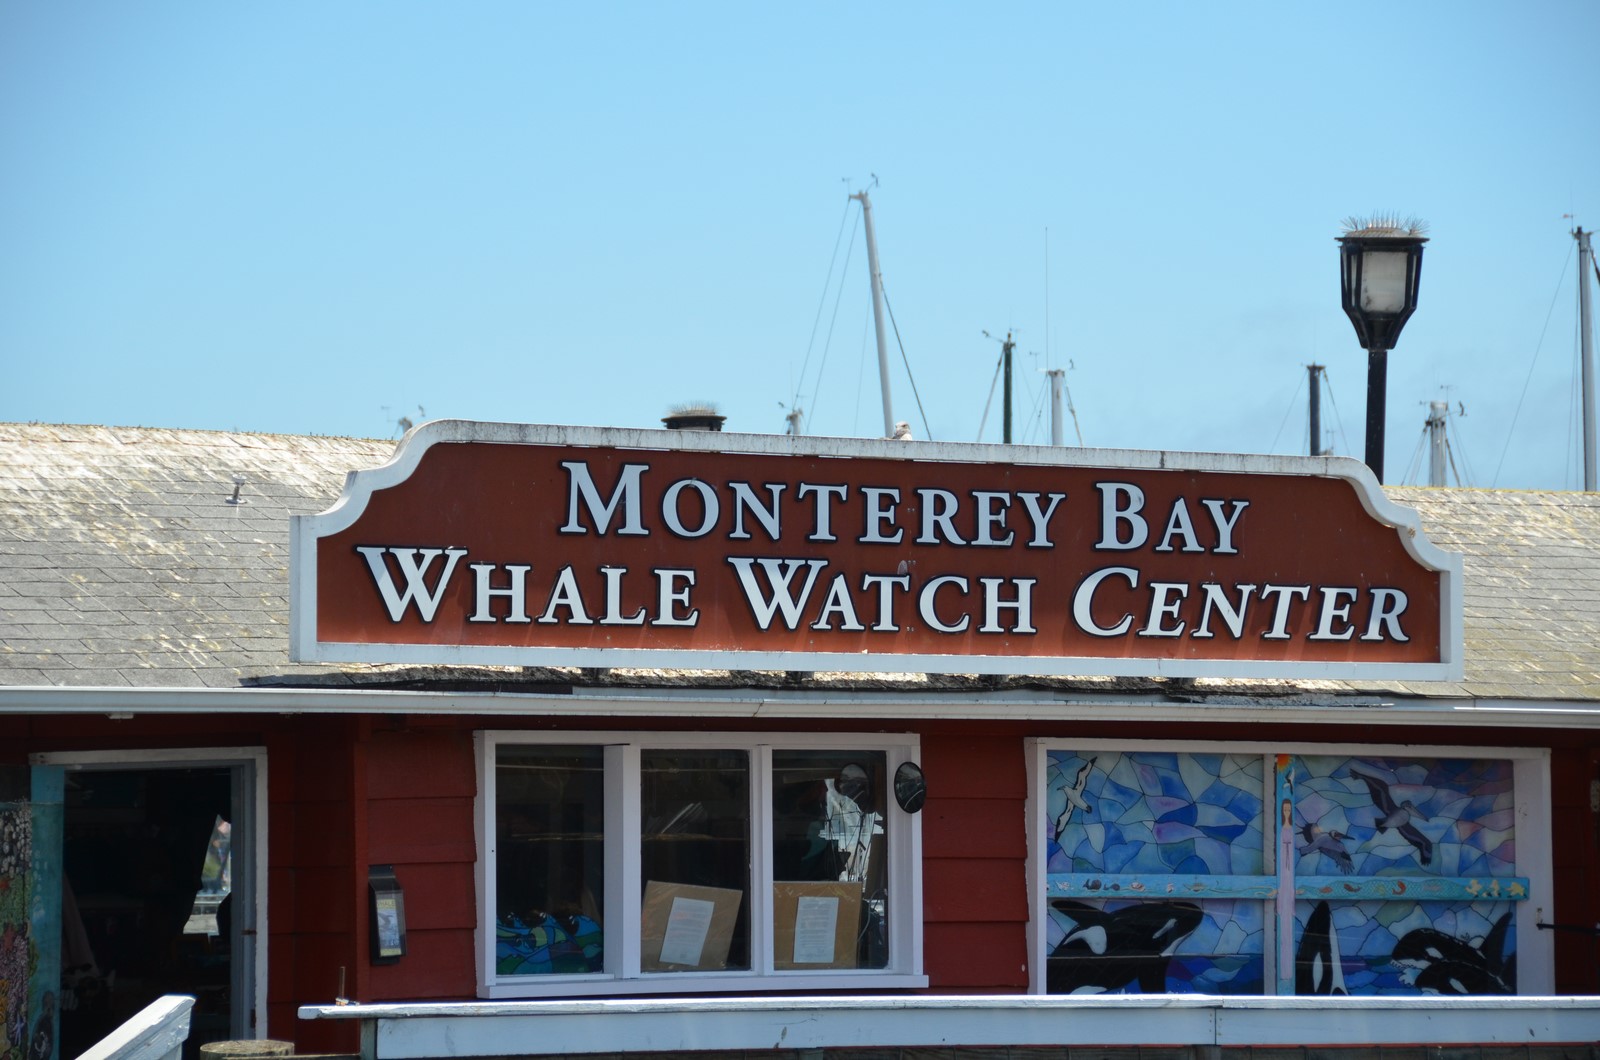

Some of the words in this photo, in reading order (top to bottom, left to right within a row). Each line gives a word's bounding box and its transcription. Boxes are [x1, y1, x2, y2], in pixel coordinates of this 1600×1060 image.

[560, 460, 1067, 549] MONTEREY
[1095, 481, 1250, 555] BAY
[355, 545, 700, 628] WHALE
[727, 556, 1038, 636] WATCH
[1072, 566, 1410, 644] CENTER
